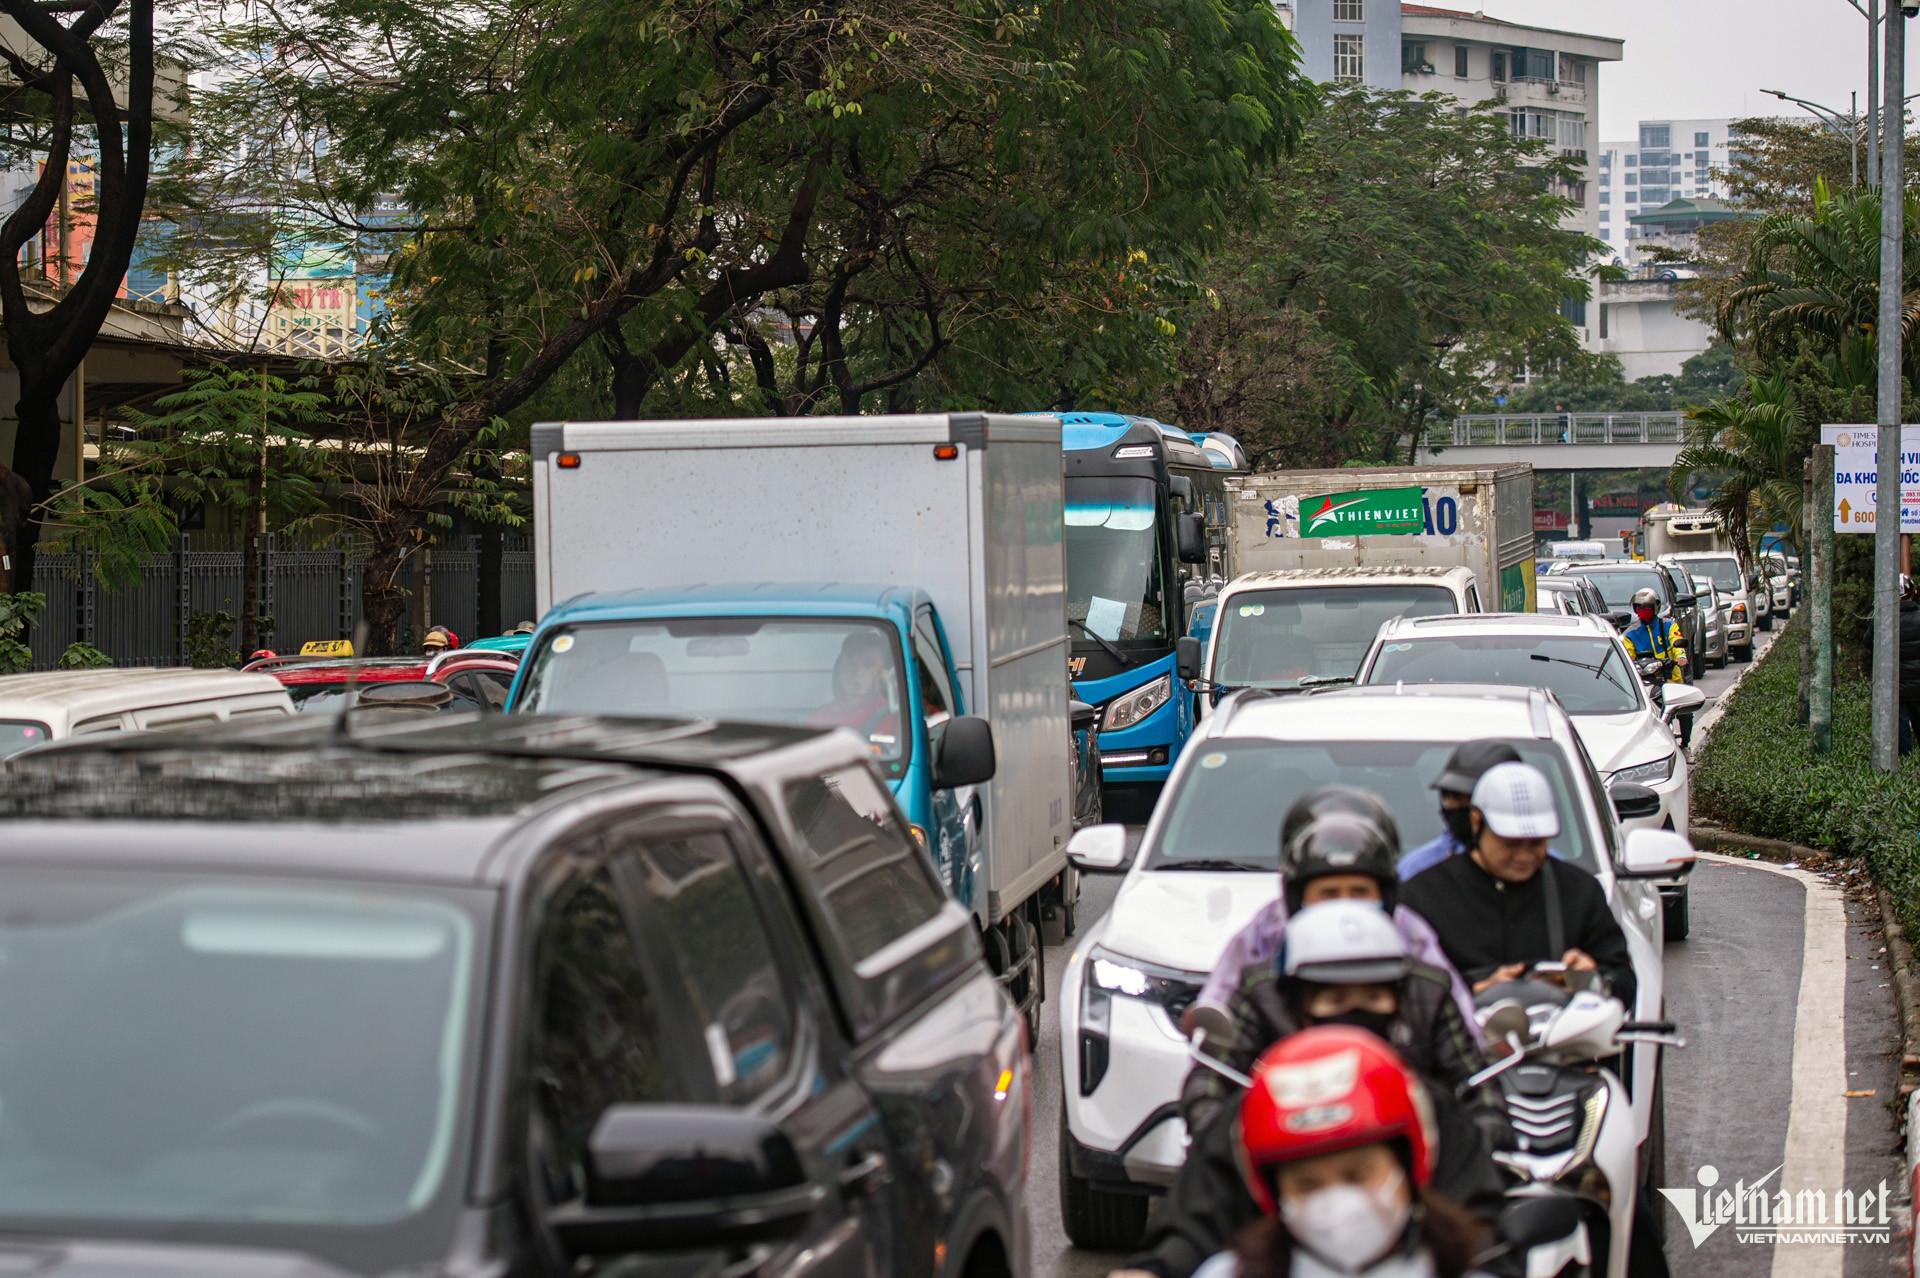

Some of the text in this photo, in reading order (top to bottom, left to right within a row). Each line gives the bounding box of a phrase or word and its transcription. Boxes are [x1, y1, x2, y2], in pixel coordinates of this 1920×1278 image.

[317, 287, 353, 309] TR
[1907, 452, 1920, 465] VI
[1836, 472, 1852, 484] ĐA
[1855, 472, 1878, 484] KHO
[1338, 508, 1418, 522] THIENVIET
[1854, 511, 1877, 523] 600
